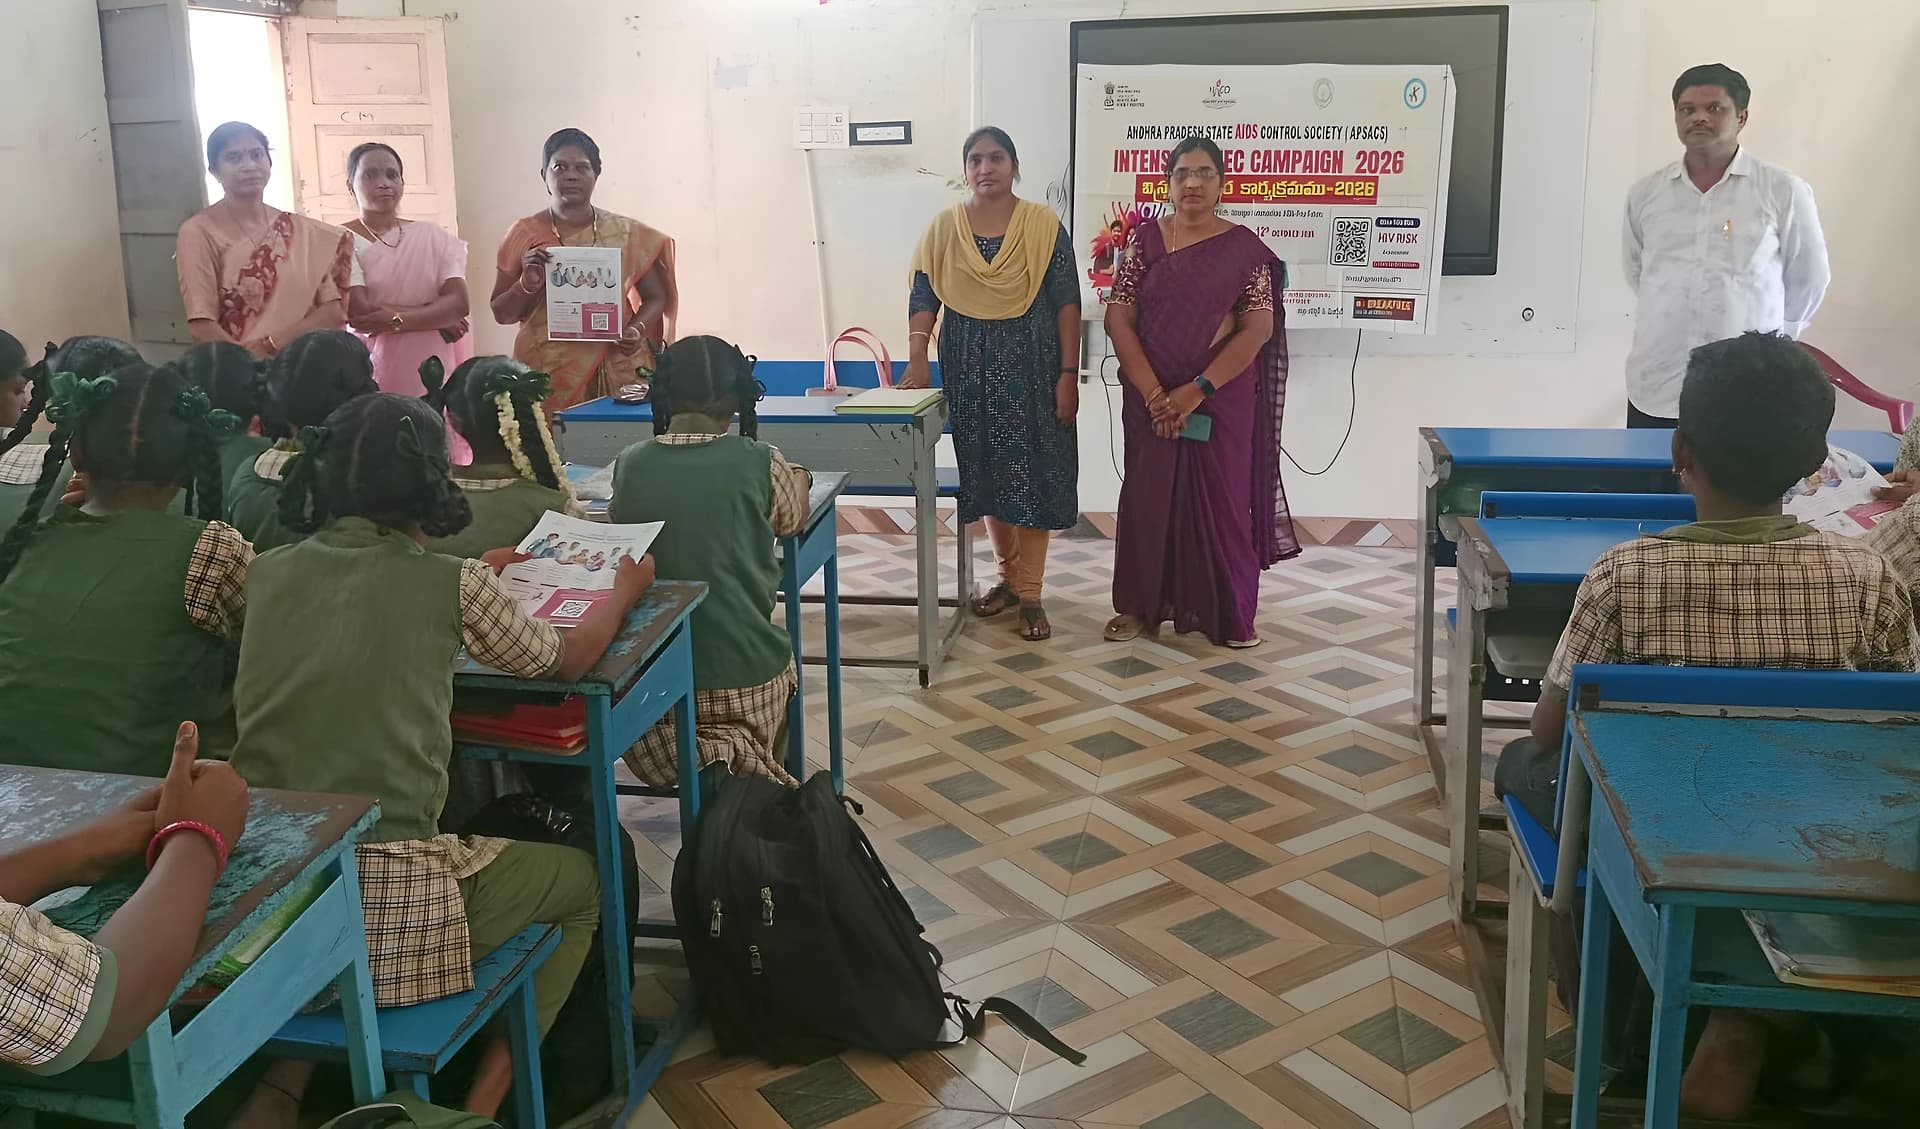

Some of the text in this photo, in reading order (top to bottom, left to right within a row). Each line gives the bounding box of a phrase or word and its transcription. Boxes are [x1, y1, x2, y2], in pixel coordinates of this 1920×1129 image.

[1126, 125, 1162, 140] ANDHRA
[1164, 125, 1204, 140] PRADESH
[1206, 125, 1233, 140] STATE
[1235, 123, 1258, 139] AIDS
[1260, 125, 1302, 140] CONTROL
[1303, 126, 1343, 140] SOCIETY
[1223, 149, 1245, 173] EC
[1250, 149, 1344, 174] CAMPAIGN
[1355, 150, 1405, 174] 2026
[1378, 232, 1418, 244] HIV RISK
